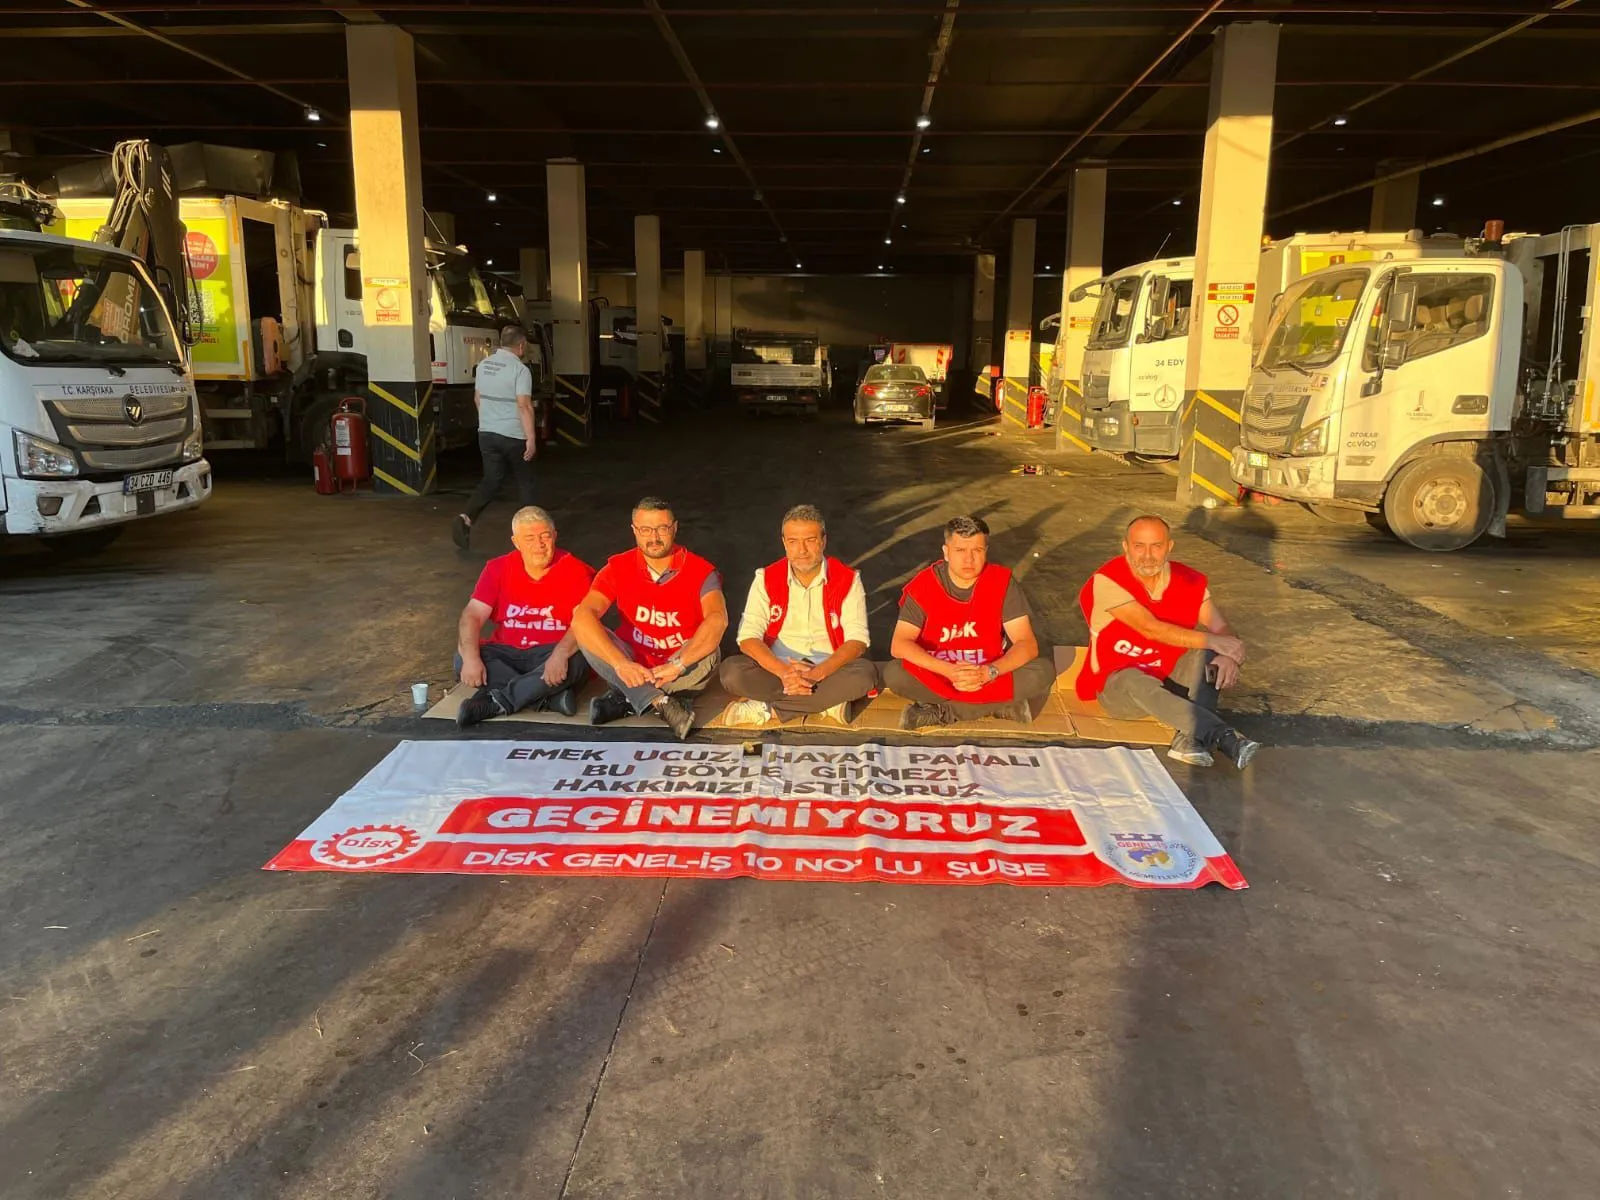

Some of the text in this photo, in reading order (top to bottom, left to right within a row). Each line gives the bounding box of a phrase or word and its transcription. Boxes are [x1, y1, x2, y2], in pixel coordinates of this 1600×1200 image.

[1155, 359, 1165, 367] 34
[130, 477, 138, 490] 34
[635, 604, 681, 628] DİSK
[505, 748, 608, 761] EMEK
[767, 750, 881, 764] HAYAT
[909, 752, 1041, 768] PAHALI
[582, 762, 960, 781] BU BÖYLE GİTMEZ!
[552, 778, 753, 793] HAKKIMIZI
[486, 800, 1041, 838] GEÇİNEMİYORUZ
[342, 837, 398, 848] DİSK
[463, 848, 555, 867] DİSK
[562, 851, 732, 872] GENEL-İŞ
[743, 852, 783, 871] 10
[946, 858, 1050, 878] ŞUBE
